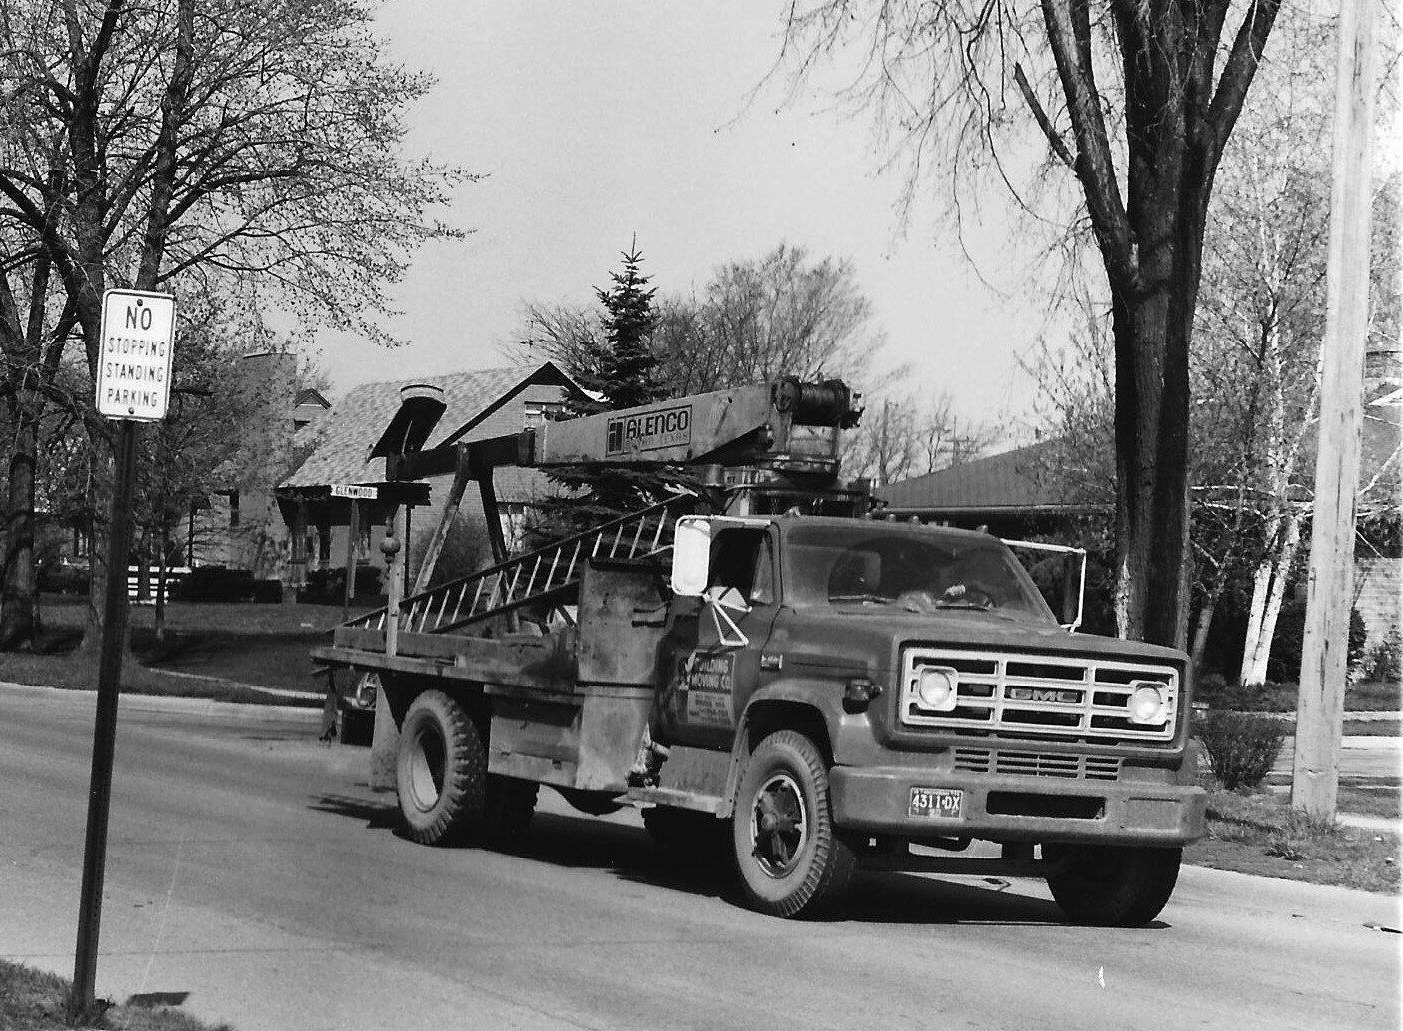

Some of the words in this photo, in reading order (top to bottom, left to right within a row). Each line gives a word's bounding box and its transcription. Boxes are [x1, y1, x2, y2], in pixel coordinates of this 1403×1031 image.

[125, 306, 152, 330] NO
[108, 337, 165, 357] STOPPING
[106, 362, 163, 383] STANDING
[107, 388, 158, 408] PARKING
[626, 410, 689, 440] ALENCO
[335, 486, 373, 498] GLENWOOD
[691, 673, 720, 689] MOVING
[1010, 688, 1078, 703] GMC
